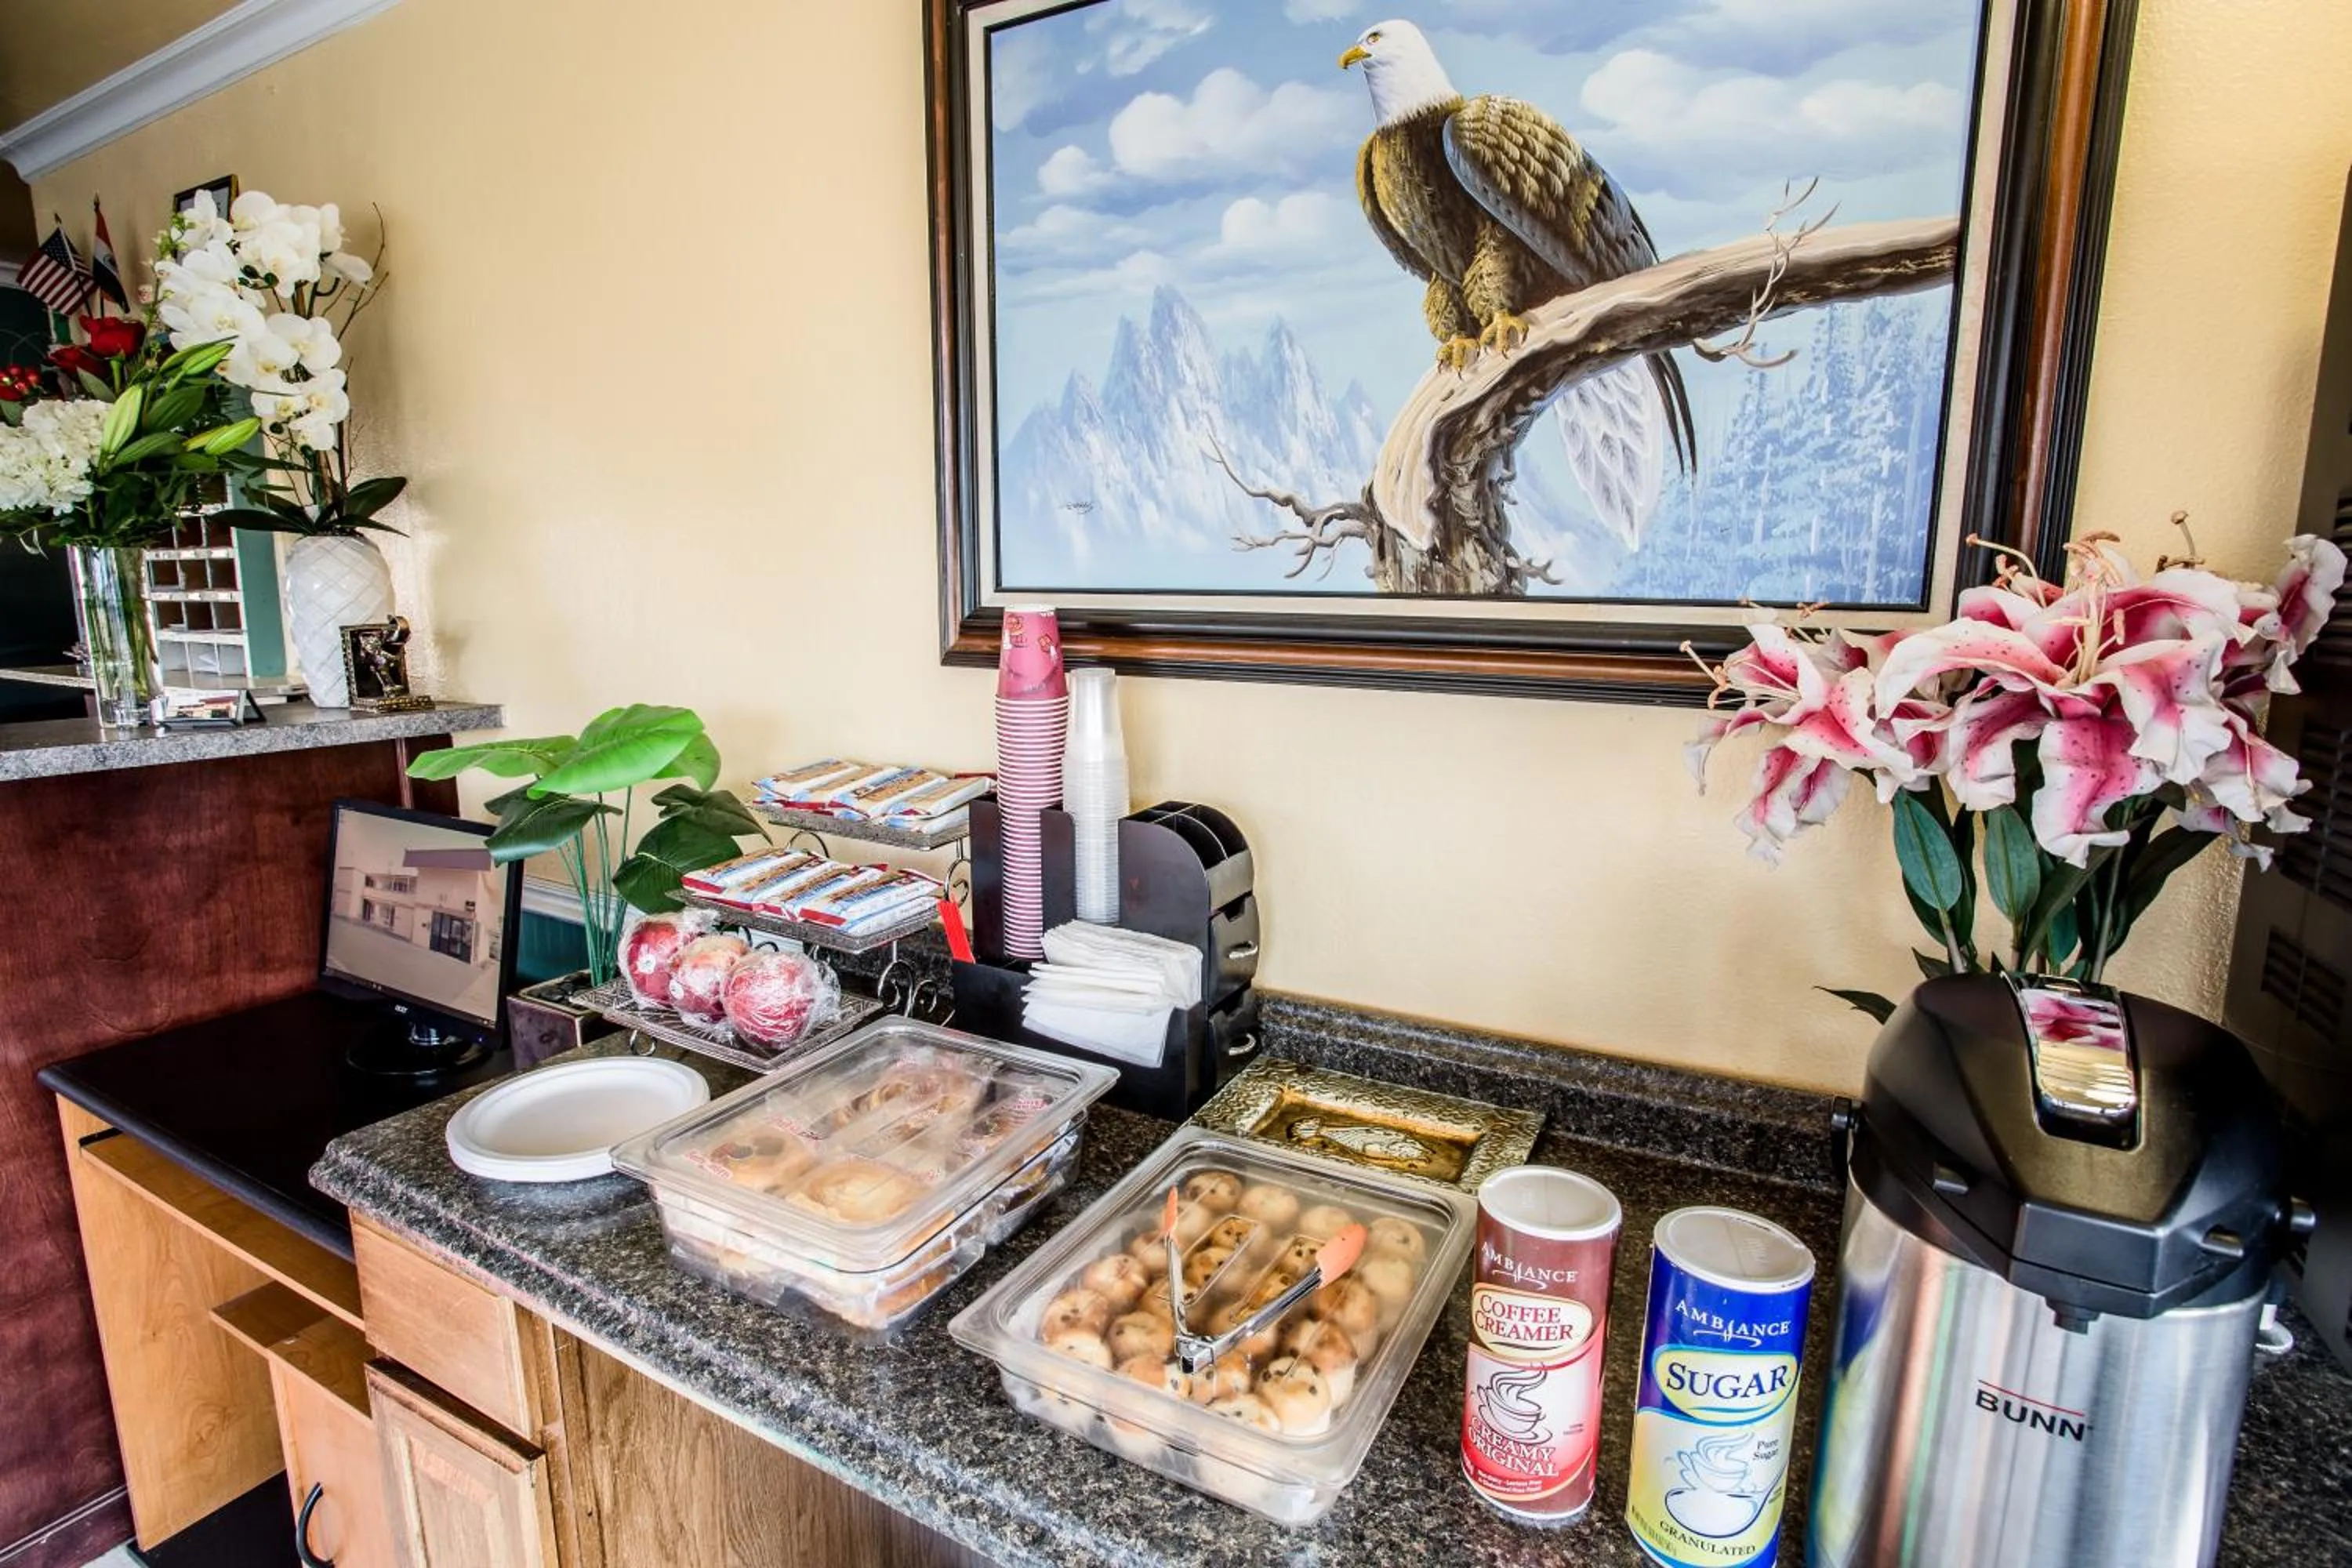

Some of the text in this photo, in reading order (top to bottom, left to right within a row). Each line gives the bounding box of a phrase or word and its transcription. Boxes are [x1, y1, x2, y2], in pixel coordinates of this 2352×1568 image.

[1481, 1241, 1578, 1286] AMBIANCE
[1475, 1310, 1574, 1341] CREAMER
[1479, 1294, 1561, 1324] COFFEE
[1675, 1299, 1791, 1343] AMBIANCE
[1666, 1361, 1788, 1399] SUGAR
[1975, 1388, 2085, 1442] BUNN
[1468, 1425, 1559, 1477] ORIGINAL
[1471, 1416, 1556, 1461] CREAMY
[1752, 1448, 1779, 1461] Sugar
[1659, 1520, 1756, 1556] GRANULATED
